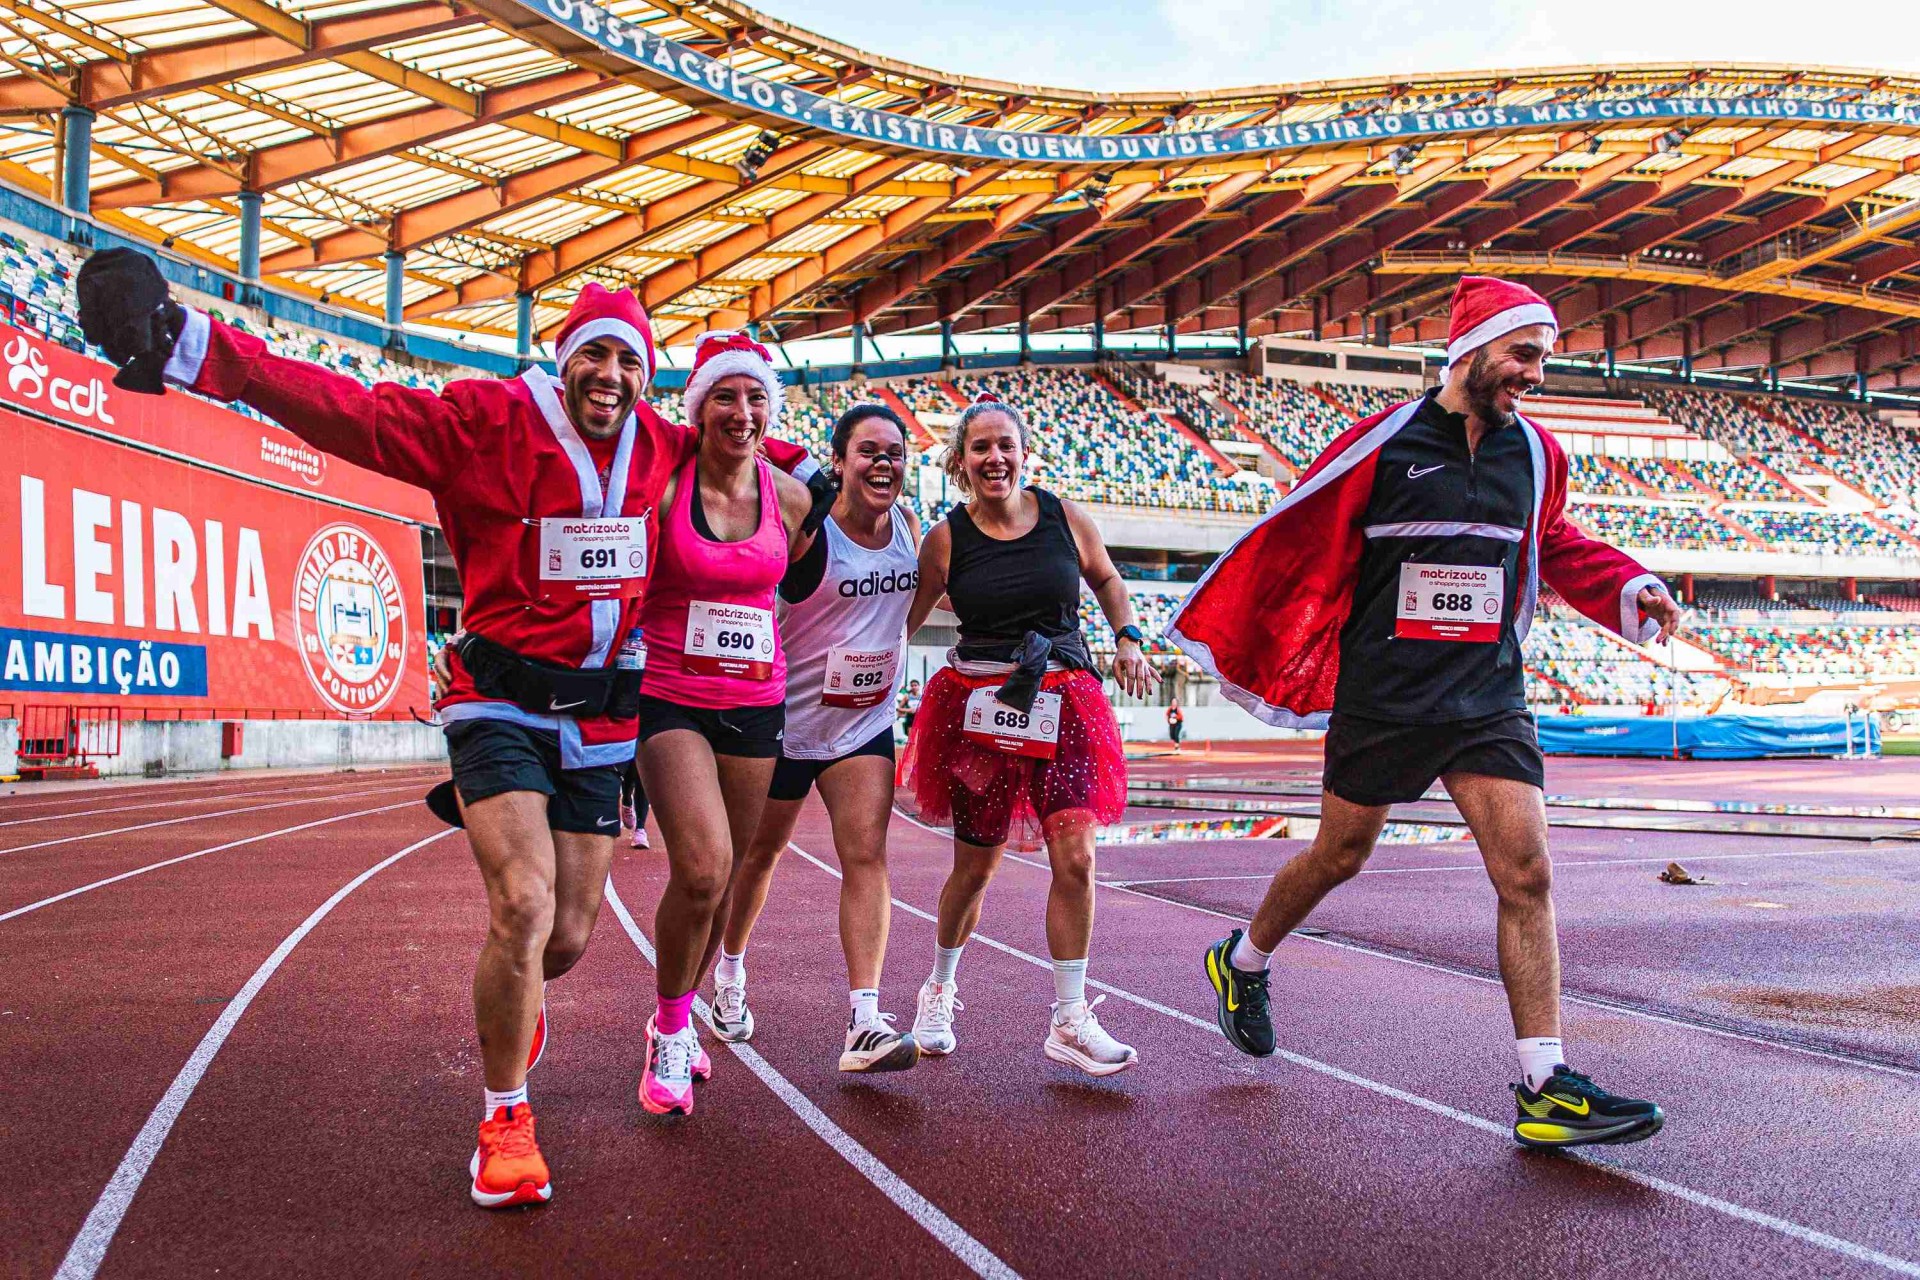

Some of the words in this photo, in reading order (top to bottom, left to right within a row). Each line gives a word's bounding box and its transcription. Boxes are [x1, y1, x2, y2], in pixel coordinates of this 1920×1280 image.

[829, 104, 982, 152] EXISTIRÁ
[997, 134, 1085, 158] QUEM
[1100, 134, 1230, 158] DUVIDE.
[1244, 115, 1402, 148] EXISTIRÃO
[1416, 107, 1518, 131] ERROS.
[1532, 101, 1588, 122] MAS
[1599, 101, 1656, 117] COM
[1667, 99, 1798, 116] TRABALHO
[49, 378, 115, 425] cdt
[261, 436, 319, 467] Supporting
[563, 523, 630, 534] matrizauto
[20, 475, 275, 641] LEIRIA
[581, 548, 616, 568] 691
[300, 539, 335, 613] UNIÃO
[338, 533, 358, 560] DE
[362, 544, 401, 622] LEIRIA
[839, 569, 918, 598] adidas
[1420, 569, 1487, 580] matrizauto
[1432, 593, 1472, 611] 688
[708, 608, 762, 621] matrizauto
[305, 634, 318, 653] 19
[717, 631, 754, 650] 690
[388, 643, 400, 660] 66
[844, 651, 893, 662] matrizauto
[4, 640, 180, 696] AMBIÇÃO
[322, 667, 390, 704] PORTUGAL
[853, 671, 883, 687] 692
[994, 711, 1030, 729] 689
